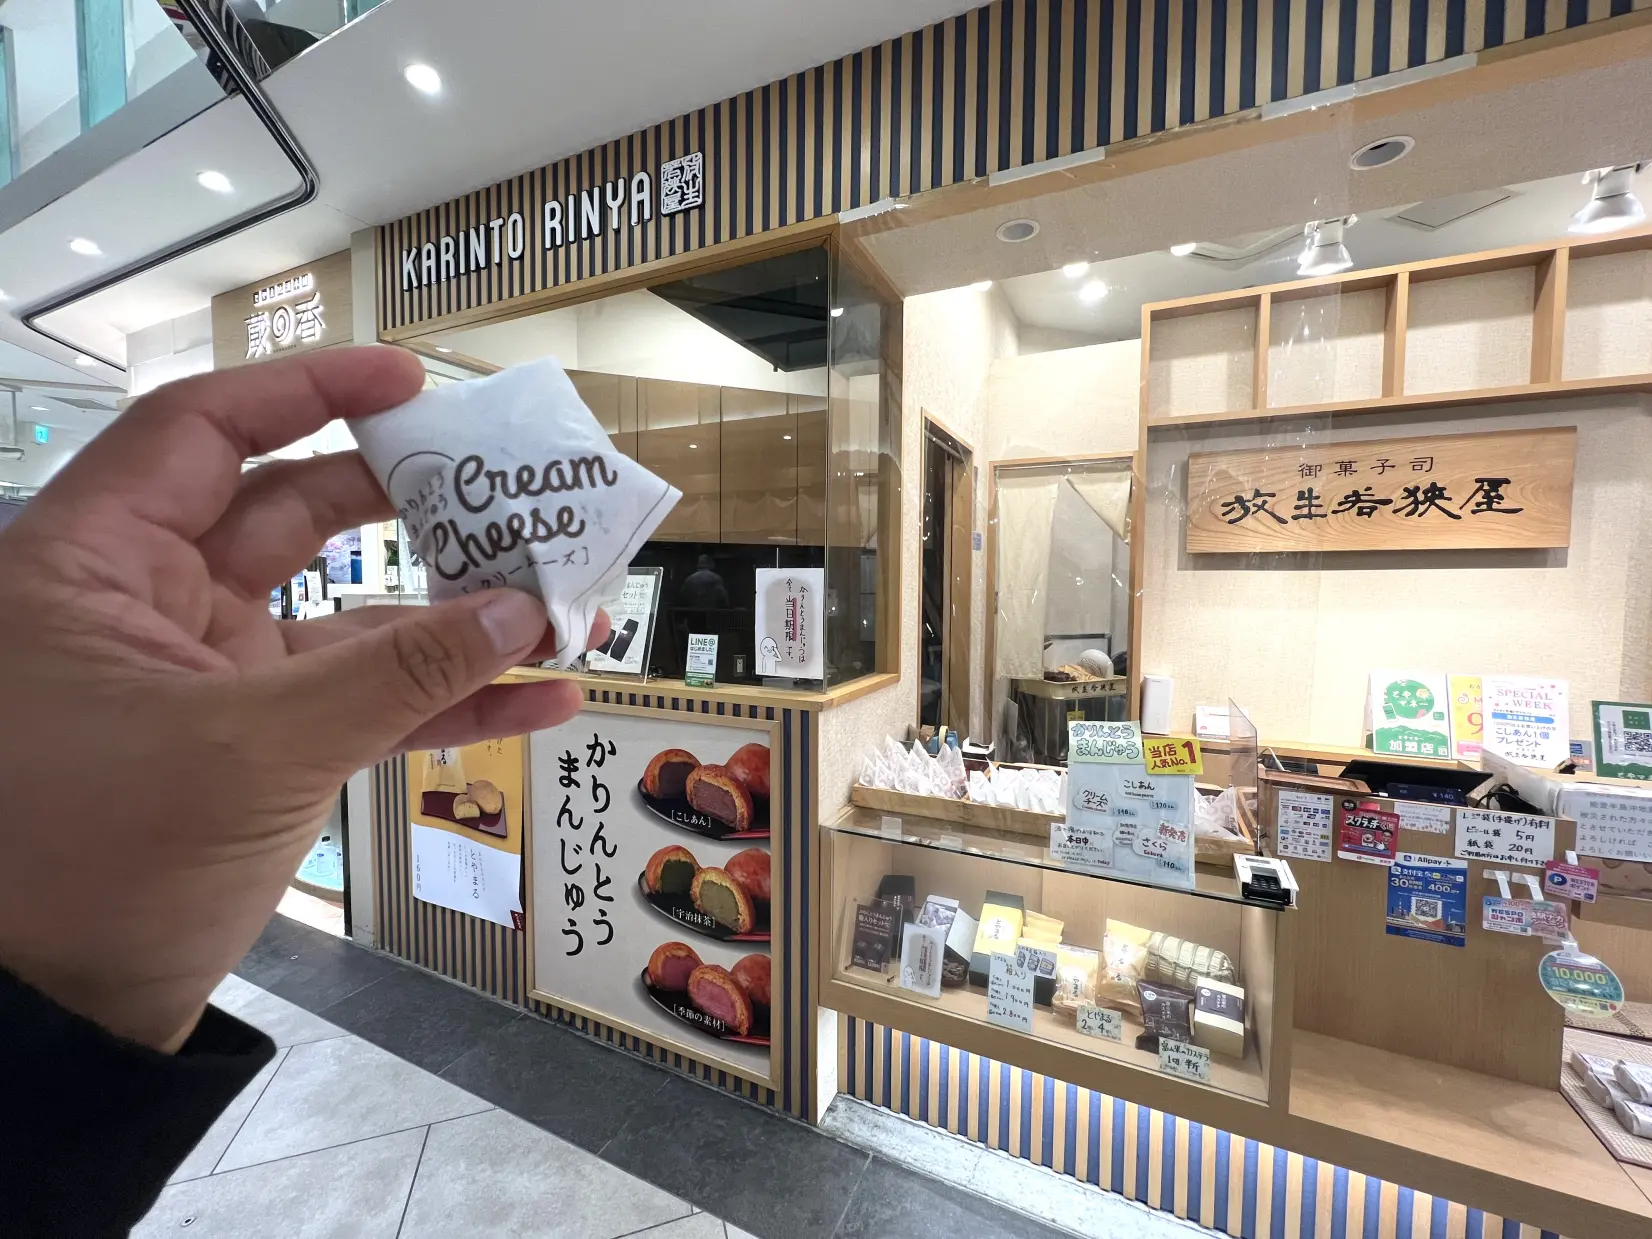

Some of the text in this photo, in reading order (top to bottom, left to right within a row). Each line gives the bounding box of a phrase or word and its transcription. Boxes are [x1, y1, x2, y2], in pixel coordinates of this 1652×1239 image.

[402, 212, 524, 291] KARINTO
[545, 171, 651, 249] RINYA
[1298, 456, 1434, 479] 御菓子司
[454, 455, 618, 514] Cream
[1221, 478, 1524, 525] 放生若狭屋
[433, 505, 586, 581] Cheese
[690, 638, 716, 647] LINE@
[1496, 688, 1553, 701] SPECIAL
[1512, 699, 1553, 710] WEEK
[1071, 723, 1135, 739] かりんとう
[1076, 739, 1140, 759] まんじゅう
[1389, 739, 1434, 755] 加盟店
[1496, 736, 1542, 748] プレゼント
[1148, 743, 1177, 759] 当店
[1123, 780, 1156, 791] こしあん
[1082, 789, 1108, 803] クリーム
[1083, 798, 1108, 809] チーズ
[671, 809, 711, 828] [こしあん]
[586, 732, 618, 946] かりんとう
[1158, 822, 1187, 843] 新発売
[1142, 837, 1168, 851] さくら
[1467, 838, 1533, 855] 紙袋 20円
[556, 749, 585, 957] まんじゅう
[1391, 877, 1409, 888] 30
[1428, 883, 1450, 894] 400
[672, 907, 716, 929] [宇治抹茶]
[1005, 964, 1026, 980] 箱入り
[673, 1003, 725, 1032] [季節の素材]
